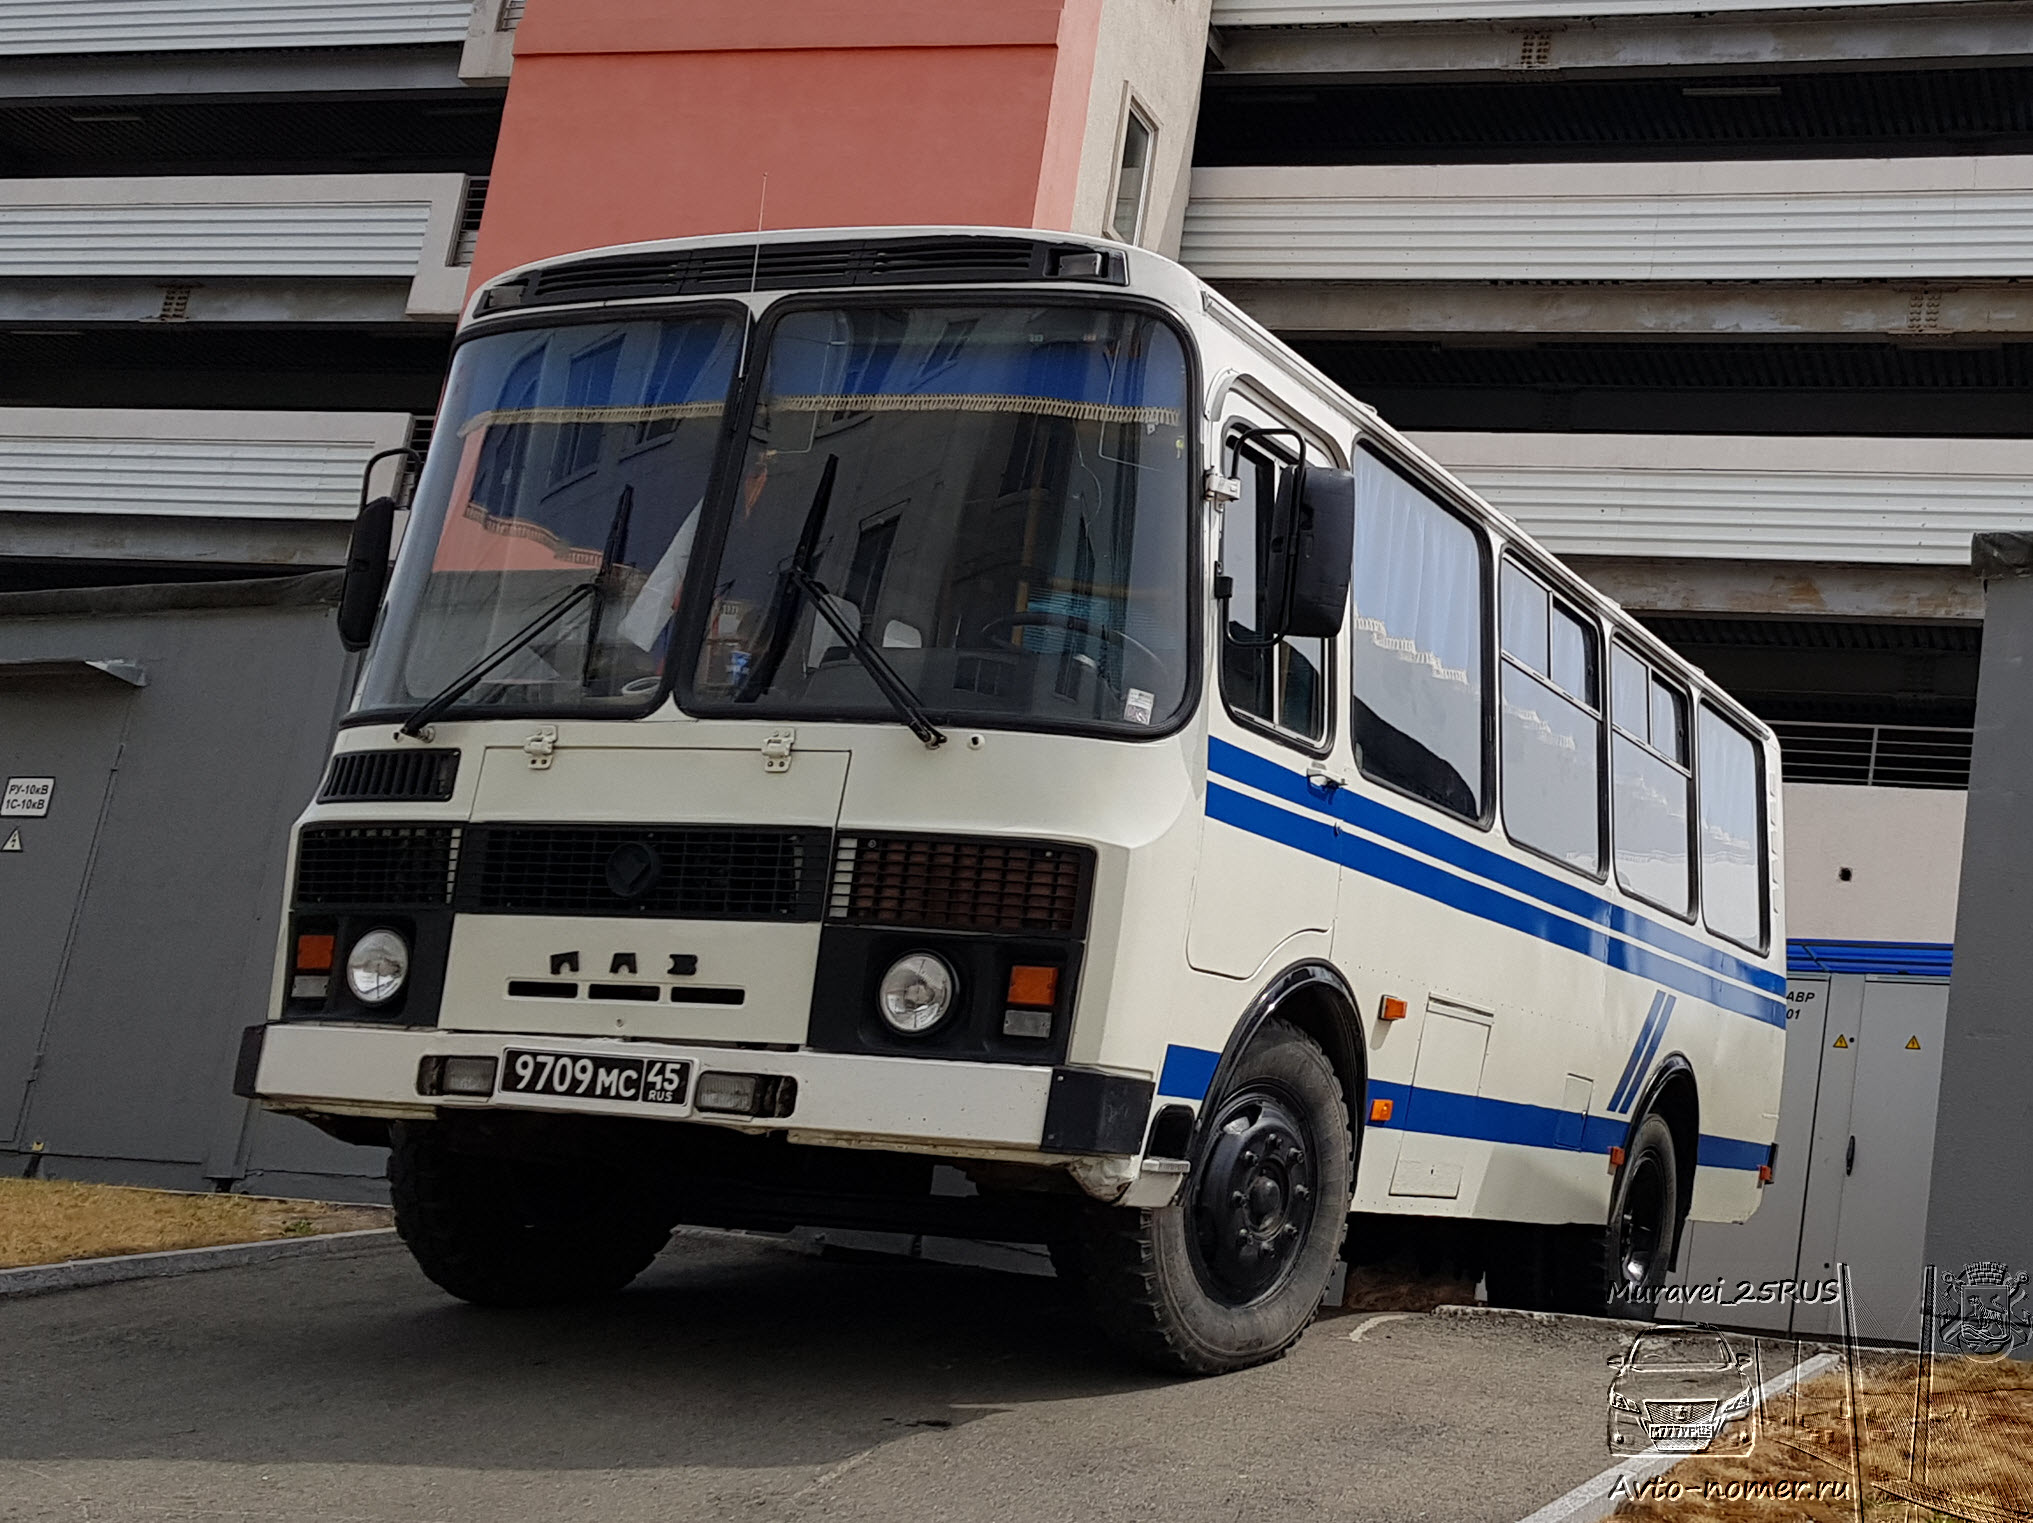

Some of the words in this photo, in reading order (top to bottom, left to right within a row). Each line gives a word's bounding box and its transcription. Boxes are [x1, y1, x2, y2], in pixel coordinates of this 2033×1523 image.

[8, 784, 49, 795] РУ-10кВ
[6, 798, 45, 810] 1С-10кВ
[647, 1062, 682, 1091] 45
[648, 1090, 673, 1102] RUS
